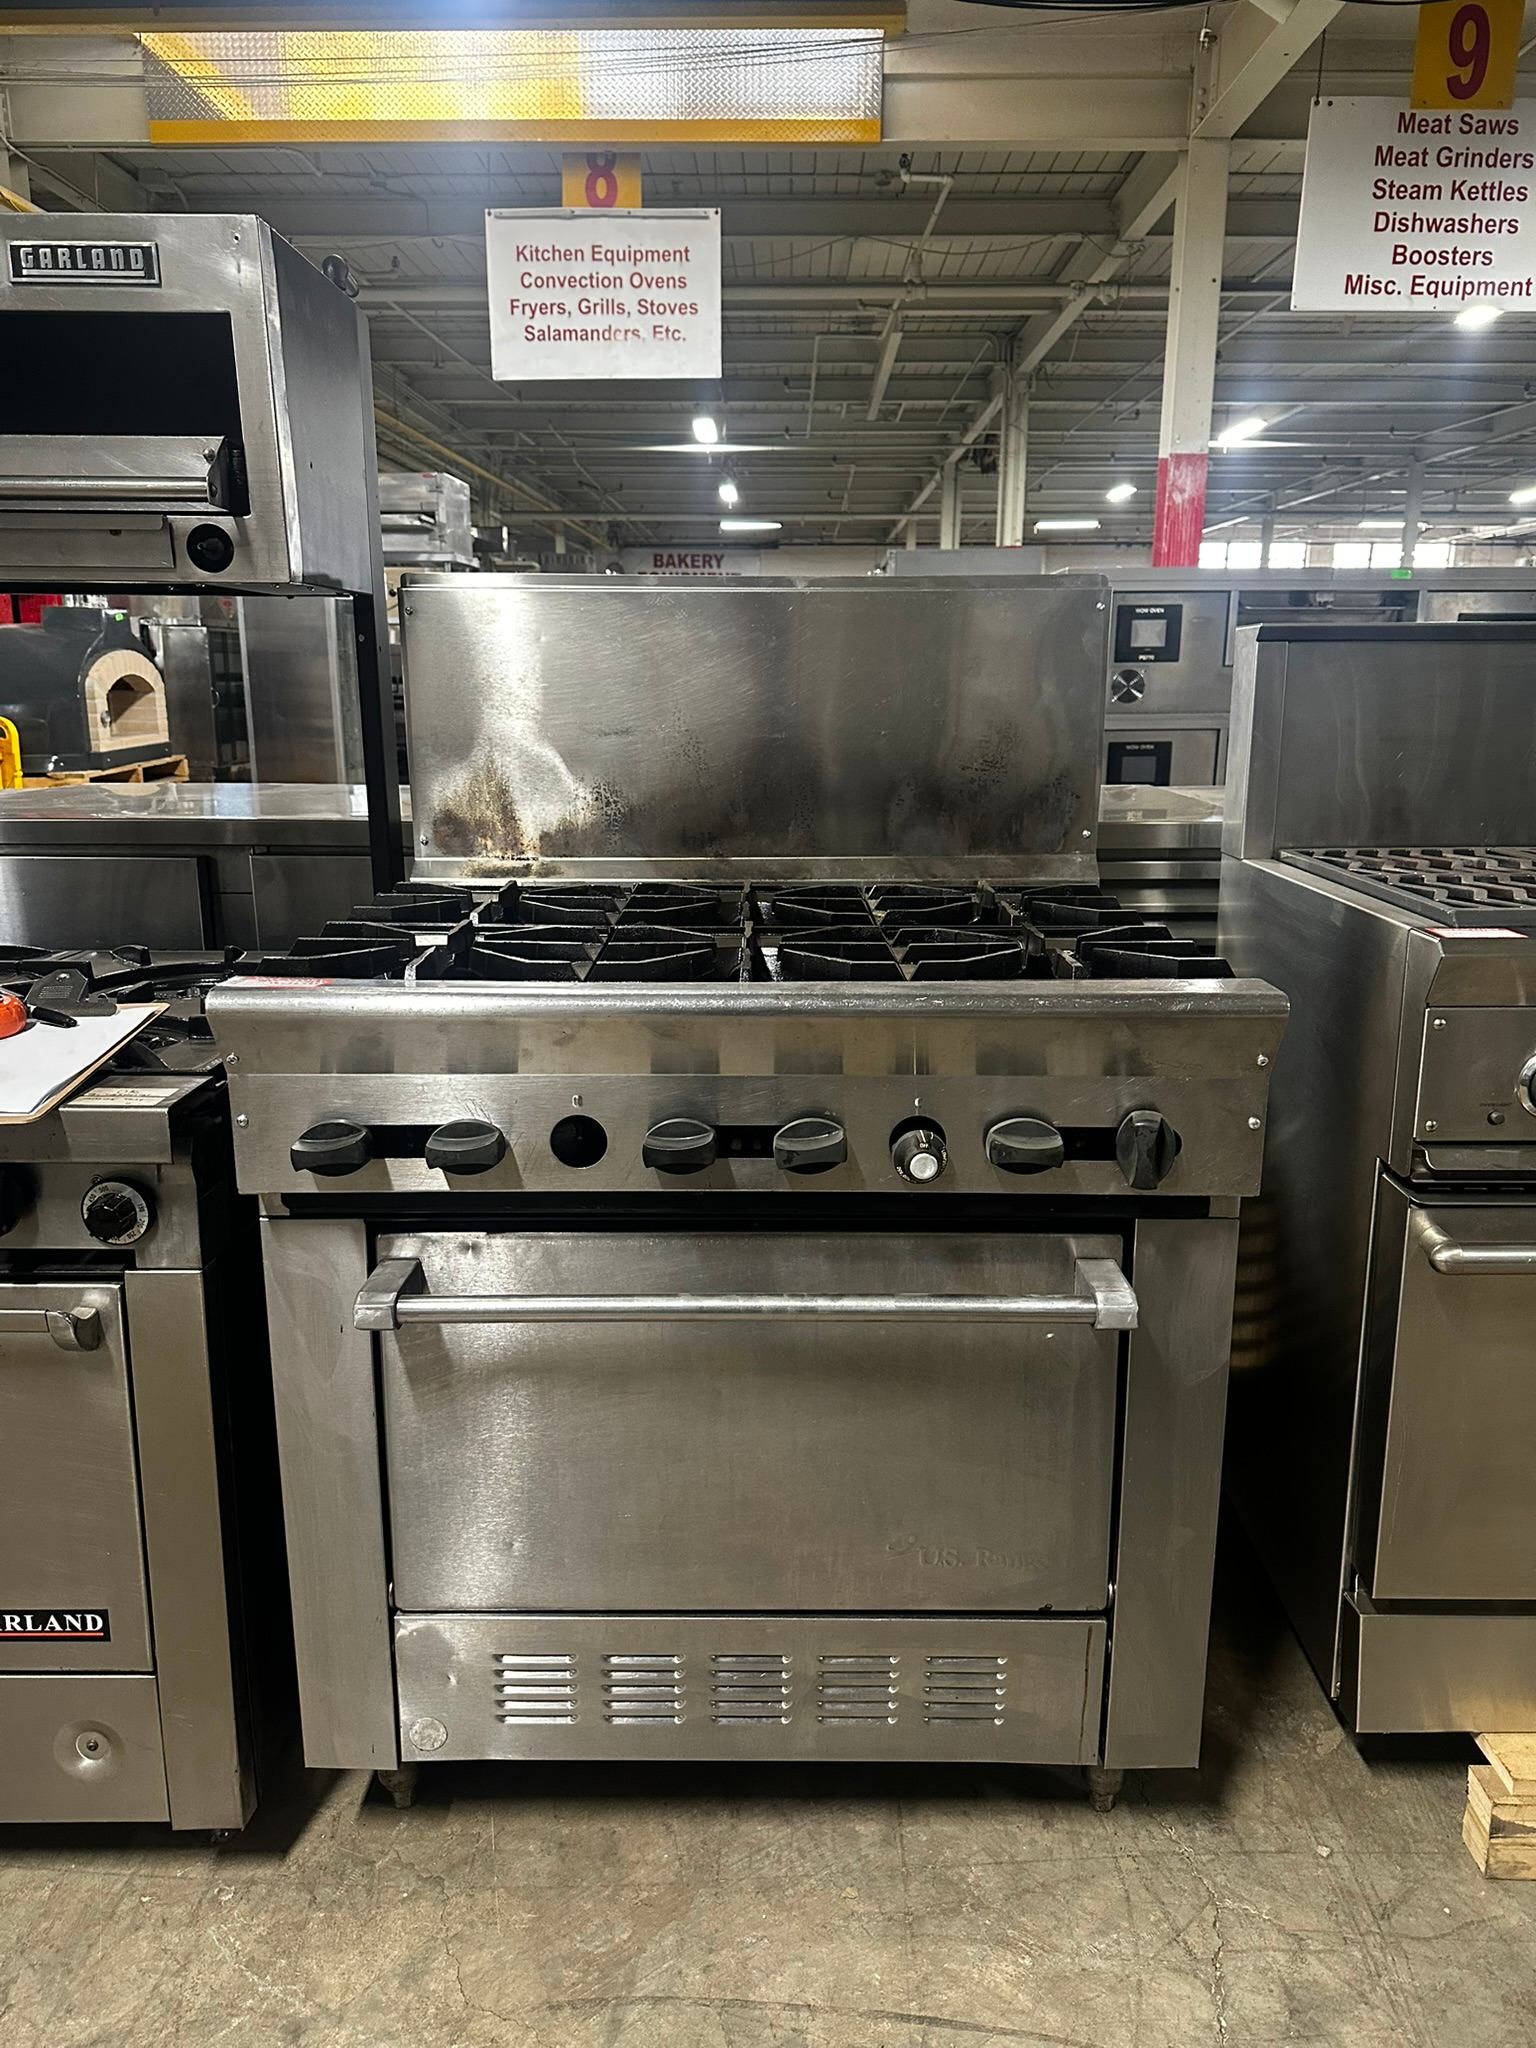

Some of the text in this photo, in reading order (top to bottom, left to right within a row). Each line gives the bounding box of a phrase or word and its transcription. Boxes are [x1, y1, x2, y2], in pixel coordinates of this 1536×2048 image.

[1446, 4, 1491, 100] 9
[1397, 112, 1520, 135] Meat Saws
[1374, 145, 1534, 169] Meat Grinders
[585, 152, 618, 207] 8
[1372, 178, 1529, 202] Steam Kettles
[1373, 211, 1519, 234] Dishwashers
[20, 247, 145, 270] GARLAND
[515, 244, 690, 266] Kitchen Equipment
[1392, 244, 1493, 266] Boosters
[520, 272, 687, 289] Convection Ovens
[1344, 274, 1533, 301] Misc. Equipment
[510, 298, 699, 319] Fryers, Grills, Stoves
[652, 325, 687, 342] Etc.
[653, 553, 725, 569] BAKERY
[0, 1613, 103, 1632] RLAND
